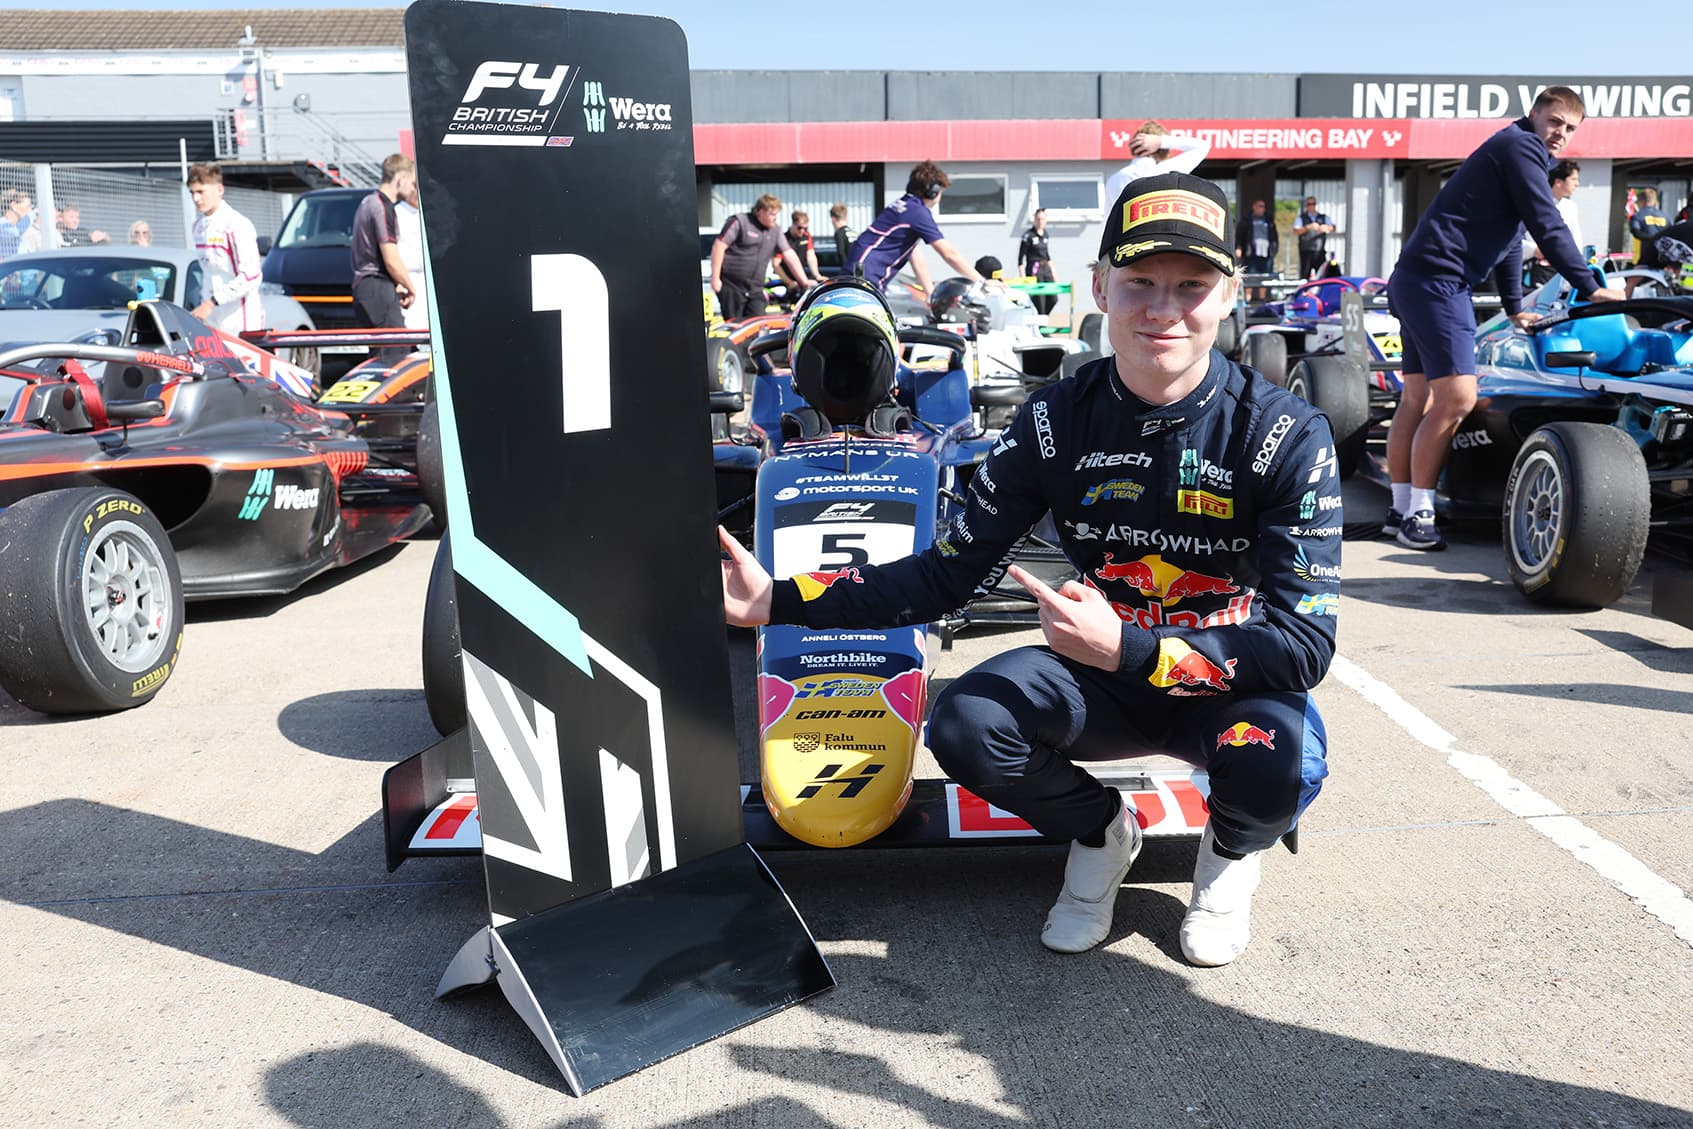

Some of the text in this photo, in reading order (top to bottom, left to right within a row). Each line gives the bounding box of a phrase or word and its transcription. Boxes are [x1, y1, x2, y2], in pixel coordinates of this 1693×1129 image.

[461, 60, 570, 106] F4
[608, 97, 672, 121] Wera
[1353, 82, 1692, 119] INFIELD VWING
[452, 106, 550, 123] BRITISH
[448, 122, 543, 132] CHAMPIONSHIP
[1327, 128, 1374, 149] BAY
[1130, 194, 1220, 231] PIRELLI
[530, 253, 612, 434] 1
[327, 385, 368, 398] 22
[1033, 400, 1056, 459] sparco
[1453, 429, 1493, 450] era
[1252, 414, 1296, 476] sparco
[774, 449, 919, 463] NYMANS UK
[1075, 451, 1153, 471] Hitech
[274, 484, 320, 510] Wera
[803, 485, 895, 494] motorsport
[1112, 490, 1139, 503] TEAM
[83, 500, 142, 534] P ZERO
[818, 533, 869, 574] 5
[974, 566, 1004, 595] YOU
[801, 634, 837, 642] ANNELI
[800, 653, 886, 665] Northbike
[795, 709, 886, 720] can-am
[825, 733, 854, 742] Falu
[825, 743, 886, 751] kommun
